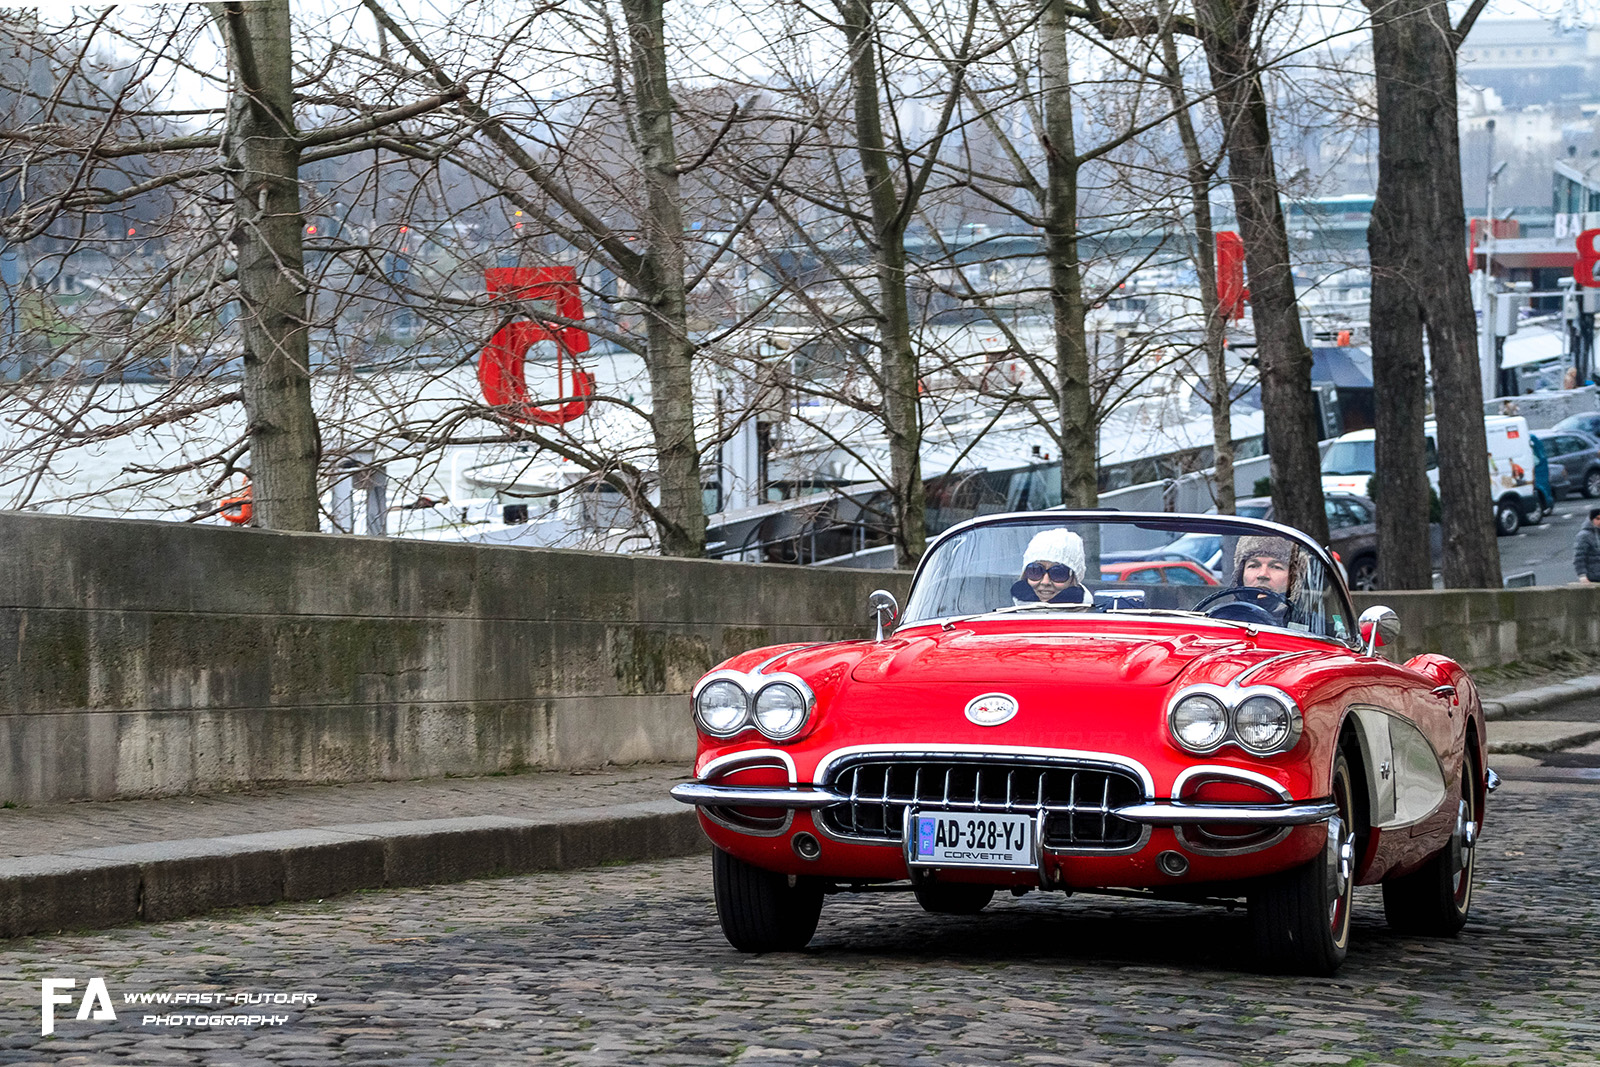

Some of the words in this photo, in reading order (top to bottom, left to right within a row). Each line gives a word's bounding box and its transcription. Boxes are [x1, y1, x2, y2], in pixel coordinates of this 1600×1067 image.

[935, 819, 1025, 851] AD-328-YJ
[922, 840, 930, 850] F
[944, 851, 1013, 861] CORVETTE
